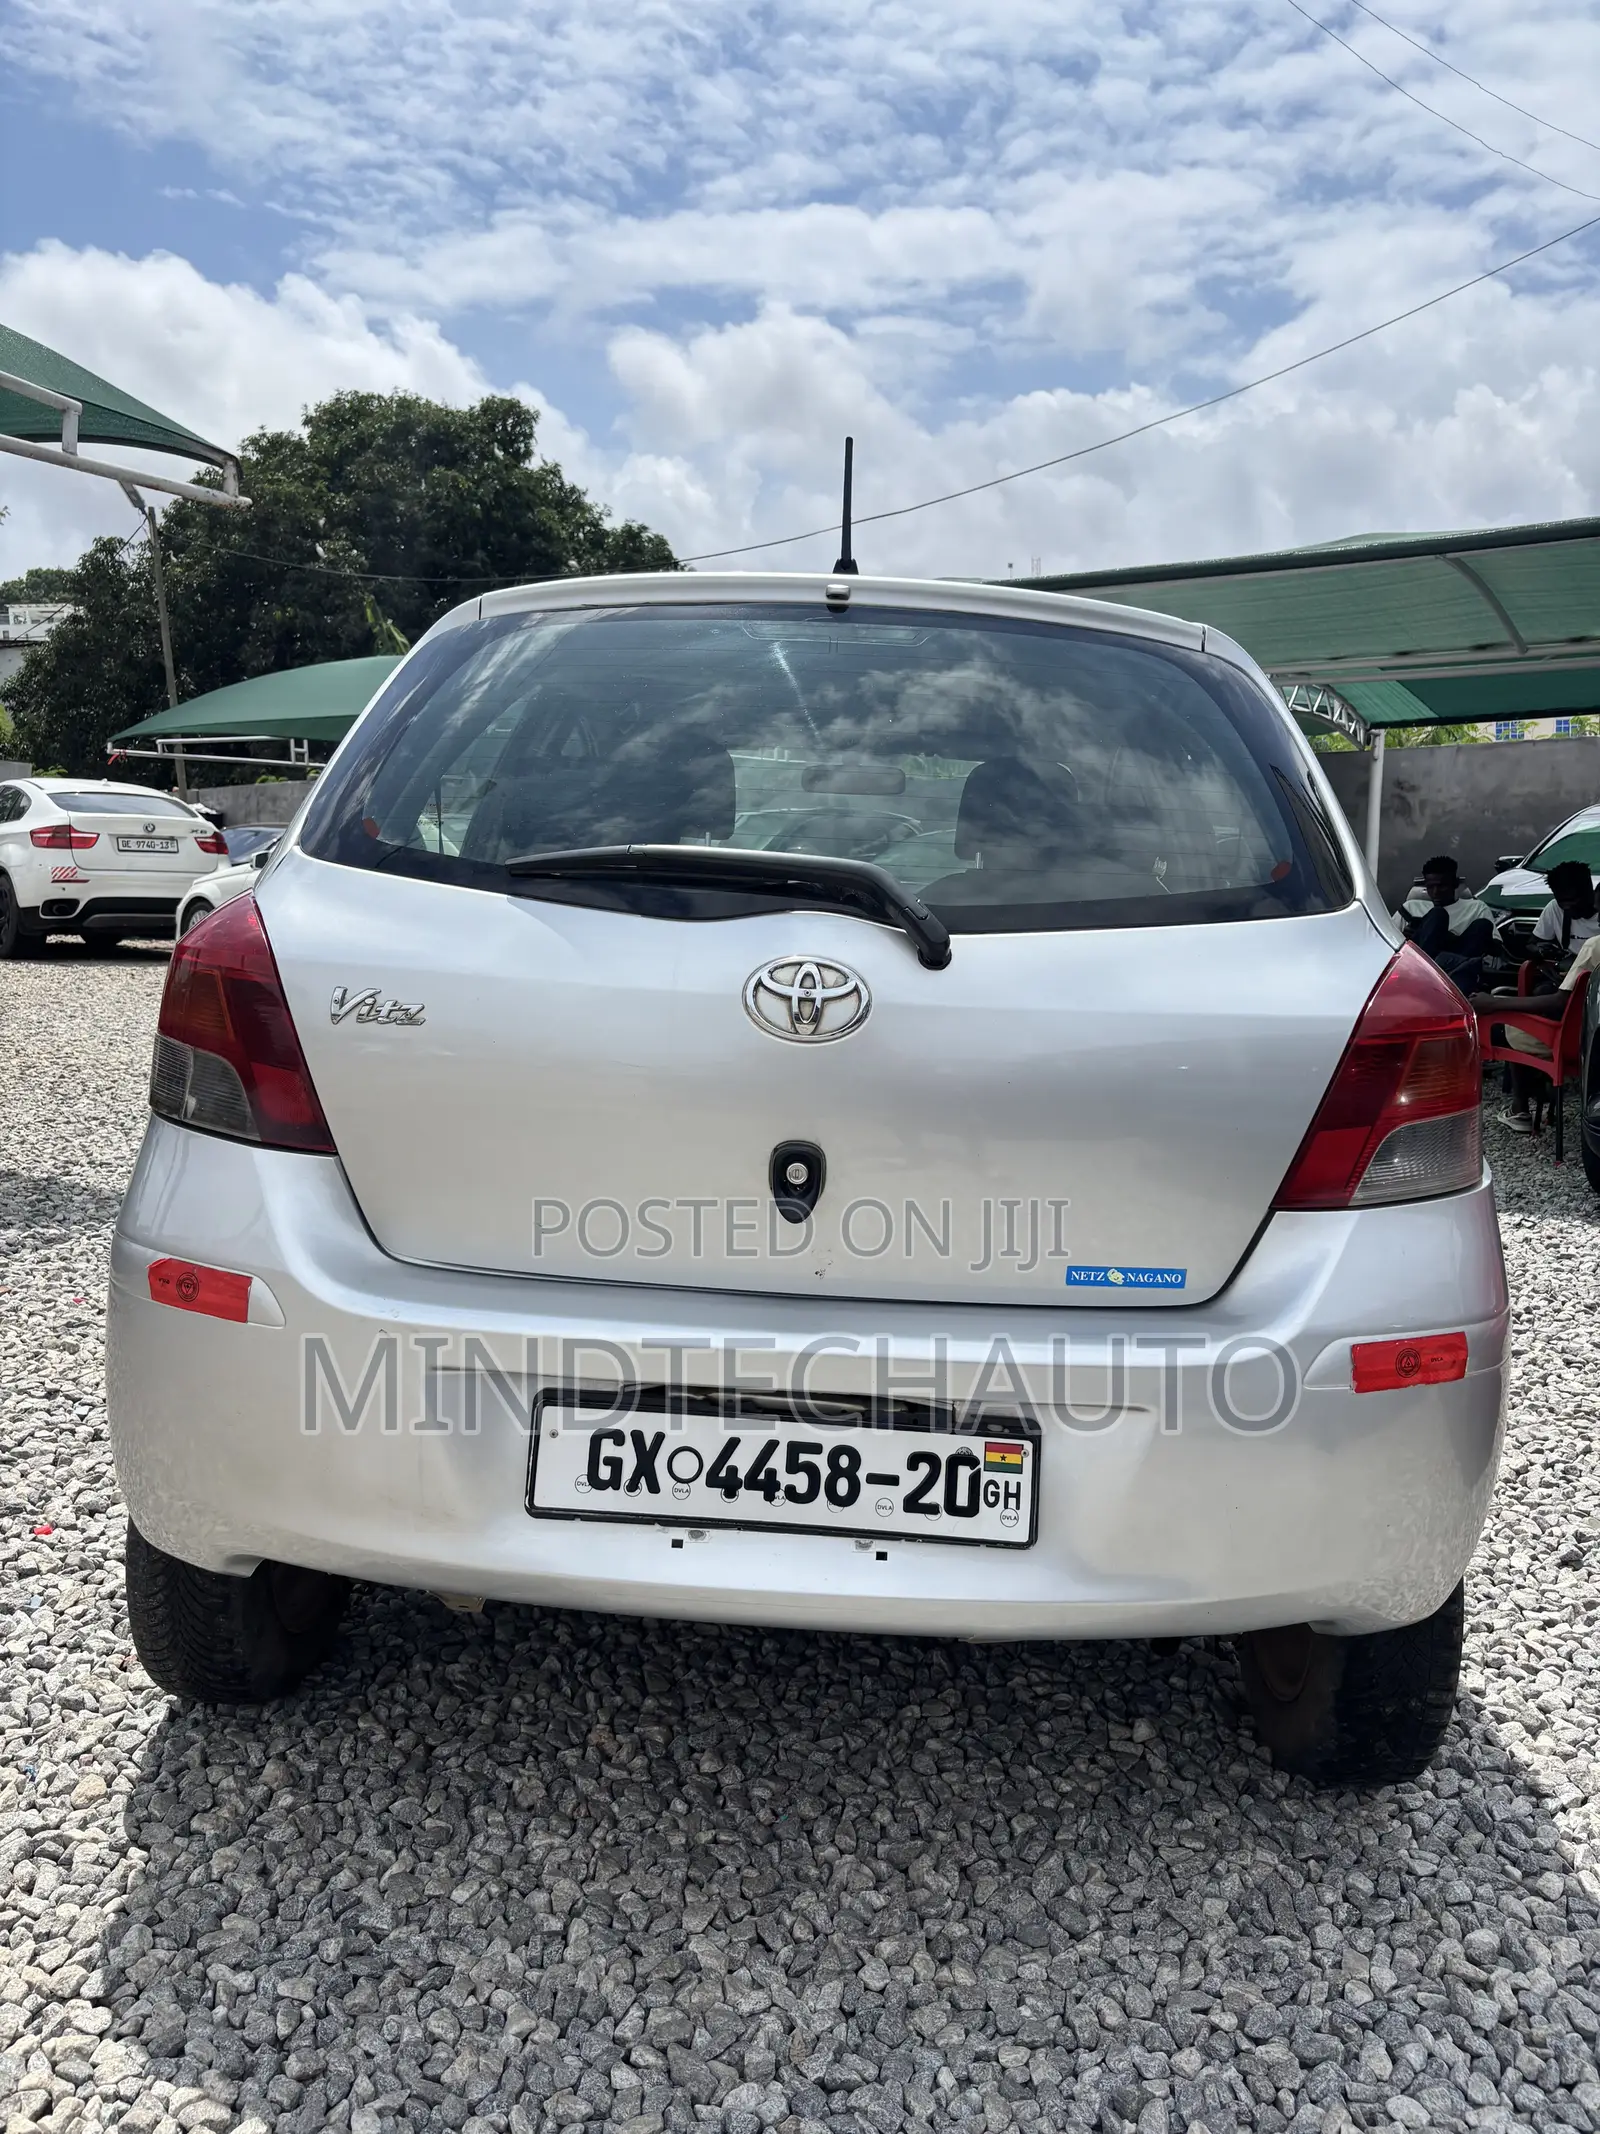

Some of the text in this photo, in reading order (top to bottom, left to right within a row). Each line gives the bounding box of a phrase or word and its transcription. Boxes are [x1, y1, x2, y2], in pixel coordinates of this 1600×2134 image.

[330, 986, 426, 1026] Vitz
[1071, 1270, 1182, 1284] NETZ NAGANO
[587, 1427, 982, 1518] GX 4458-20
[983, 1478, 1021, 1510] GH
